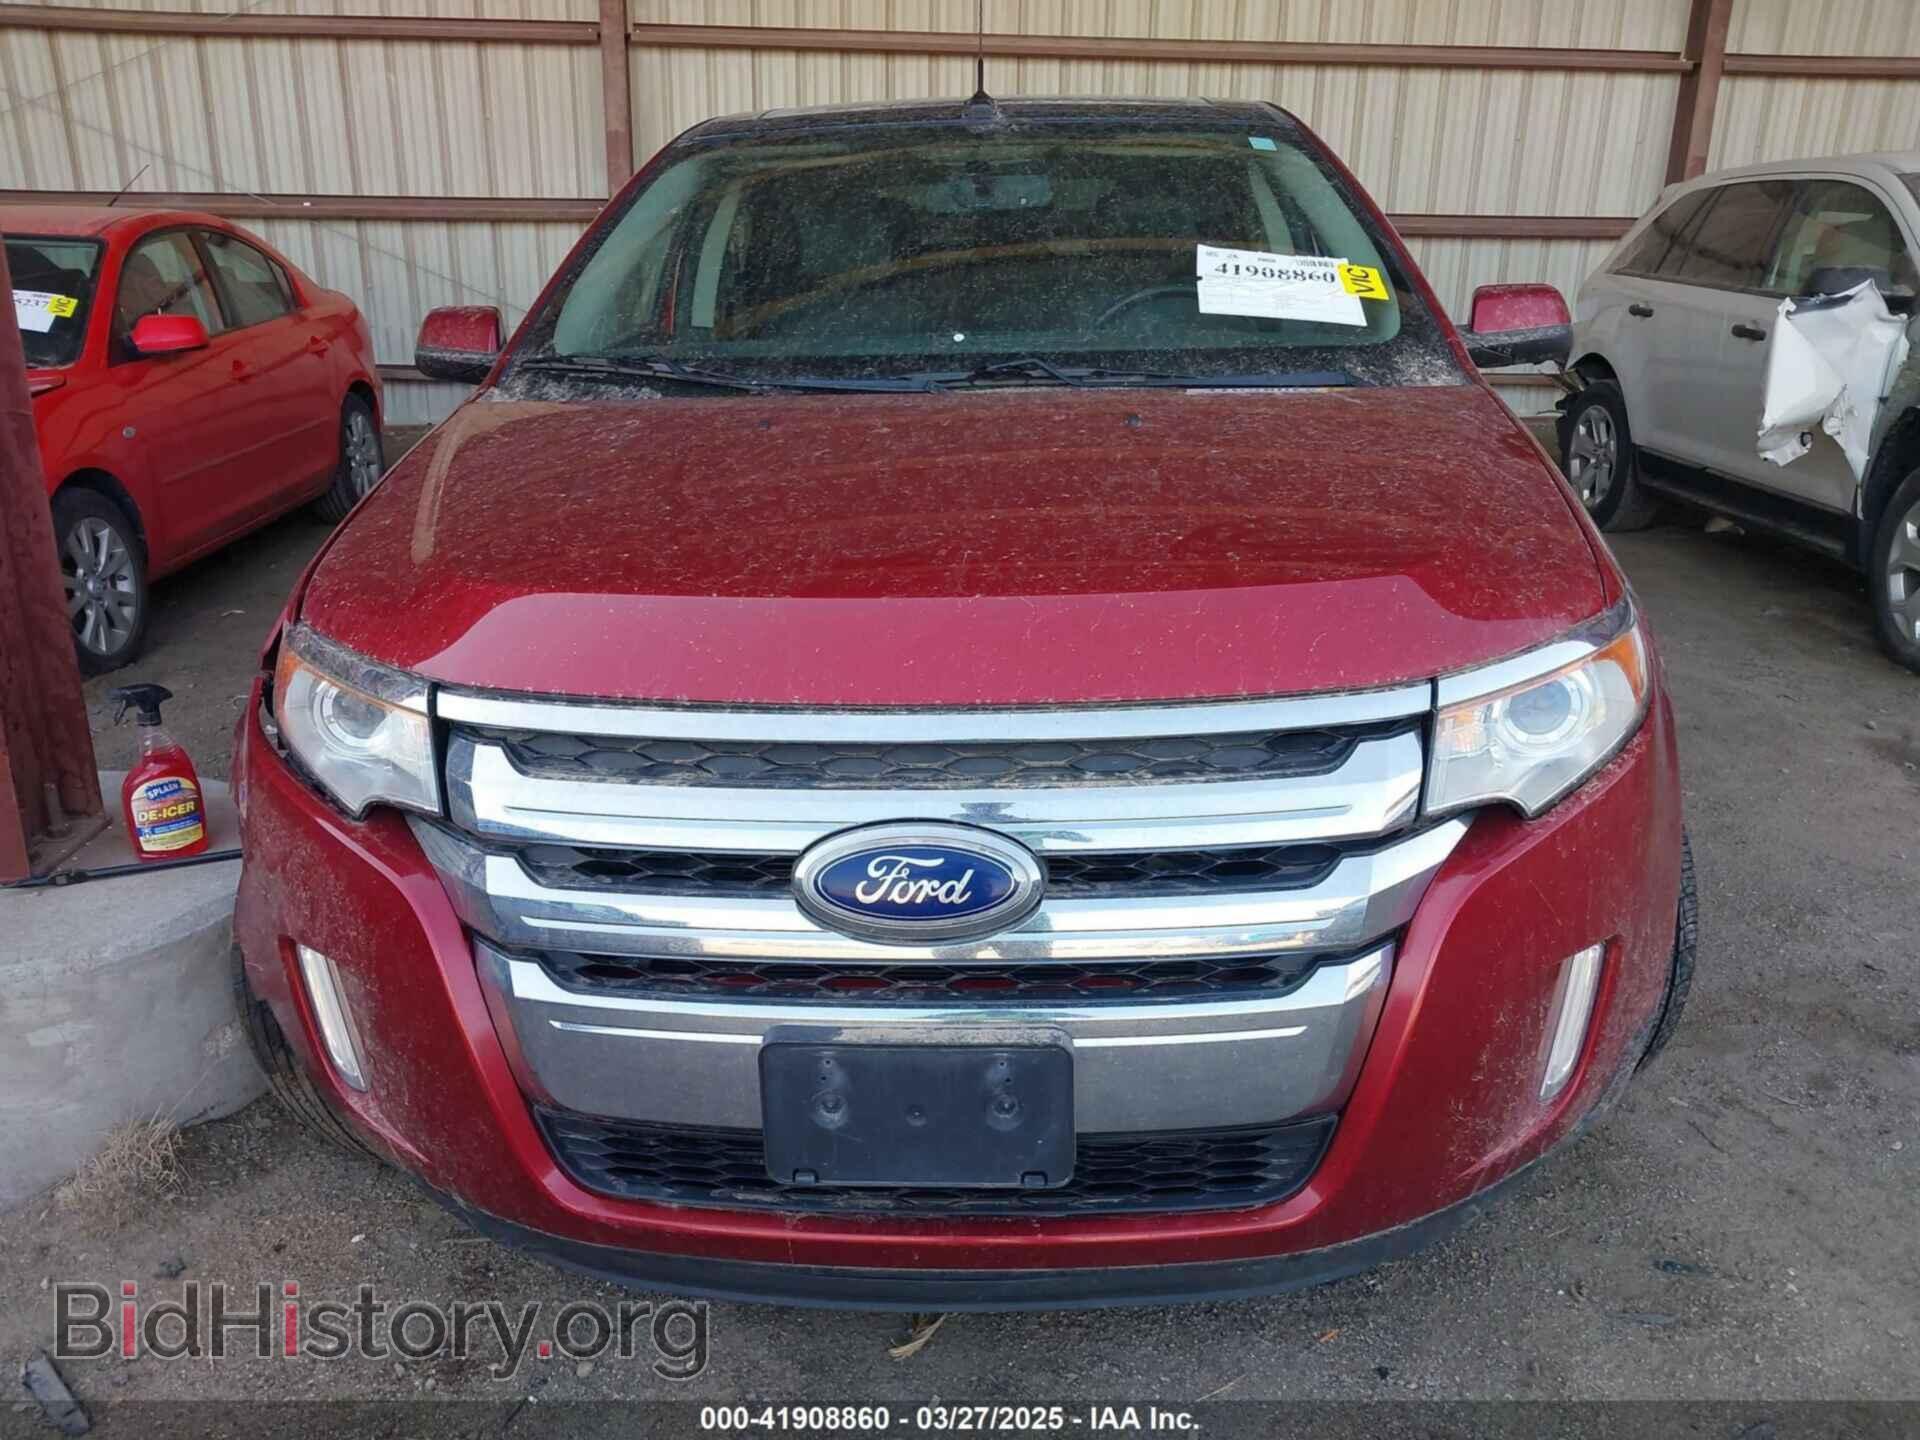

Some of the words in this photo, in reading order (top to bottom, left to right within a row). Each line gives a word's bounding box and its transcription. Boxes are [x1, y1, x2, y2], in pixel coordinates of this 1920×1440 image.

[1214, 262, 1336, 284] 41908860
[1347, 267, 1375, 294] VIC
[51, 298, 71, 313] VIC
[138, 801, 195, 821] DE-ICER
[855, 855, 975, 904] Ford
